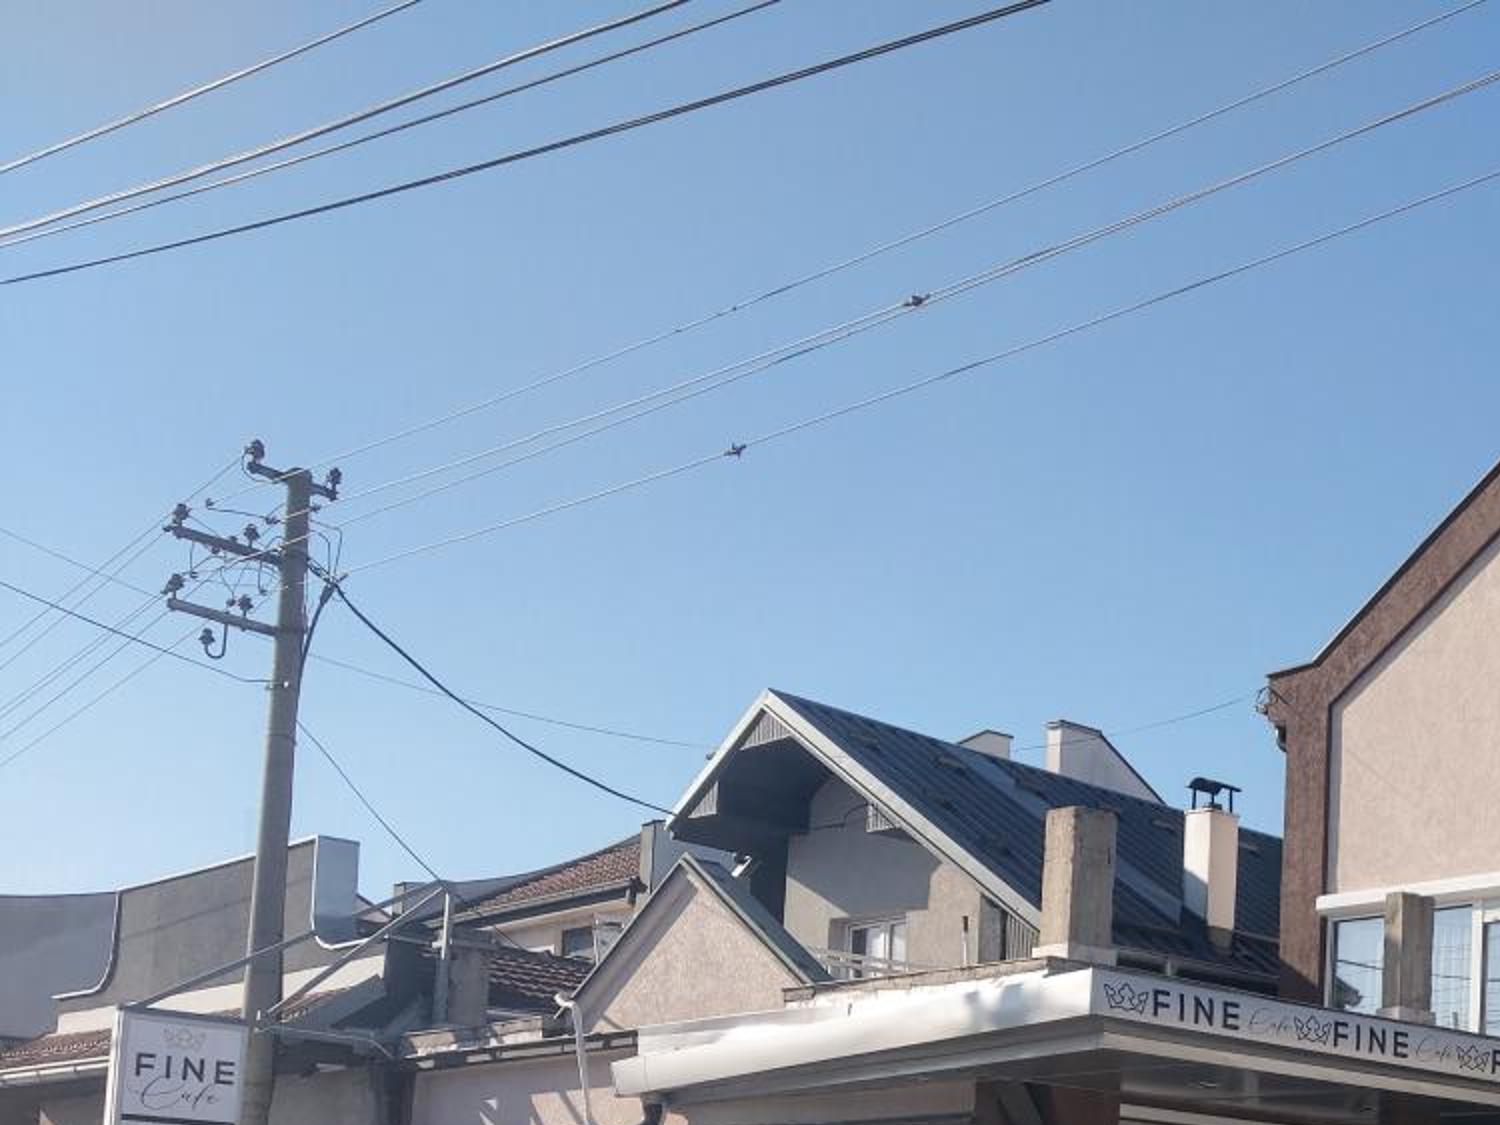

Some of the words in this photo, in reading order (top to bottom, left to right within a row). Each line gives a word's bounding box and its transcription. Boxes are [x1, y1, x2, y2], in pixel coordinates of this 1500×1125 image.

[1153, 988, 1241, 1030] FINE
[1333, 1021, 1409, 1058] FINE
[135, 1052, 236, 1085] FINE
